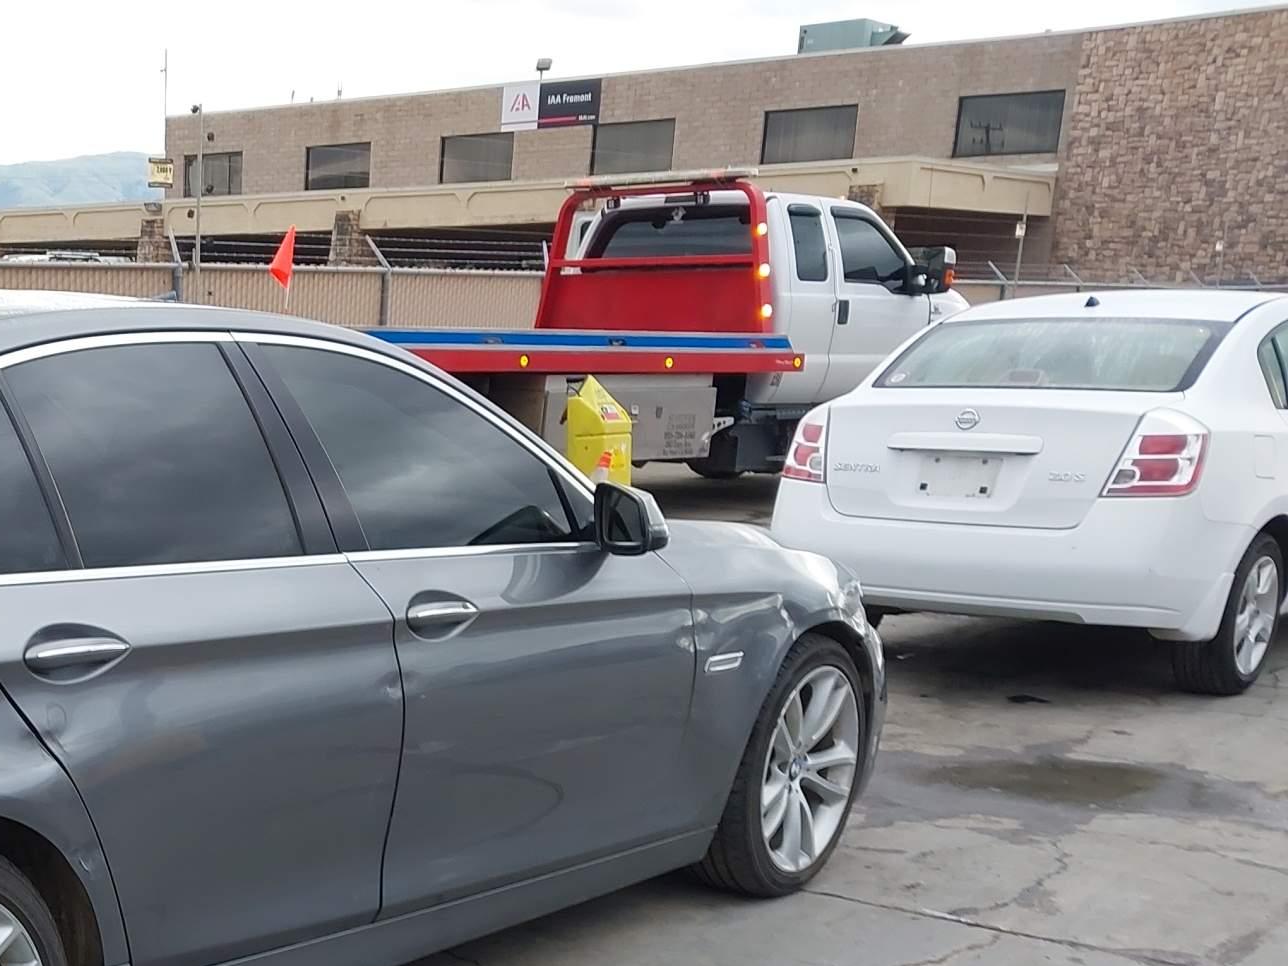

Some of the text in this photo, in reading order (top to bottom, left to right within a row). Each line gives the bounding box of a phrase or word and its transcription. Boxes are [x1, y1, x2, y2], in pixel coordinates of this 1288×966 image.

[547, 92, 592, 105] IAA Fremont
[833, 462, 881, 473] SENTRA
